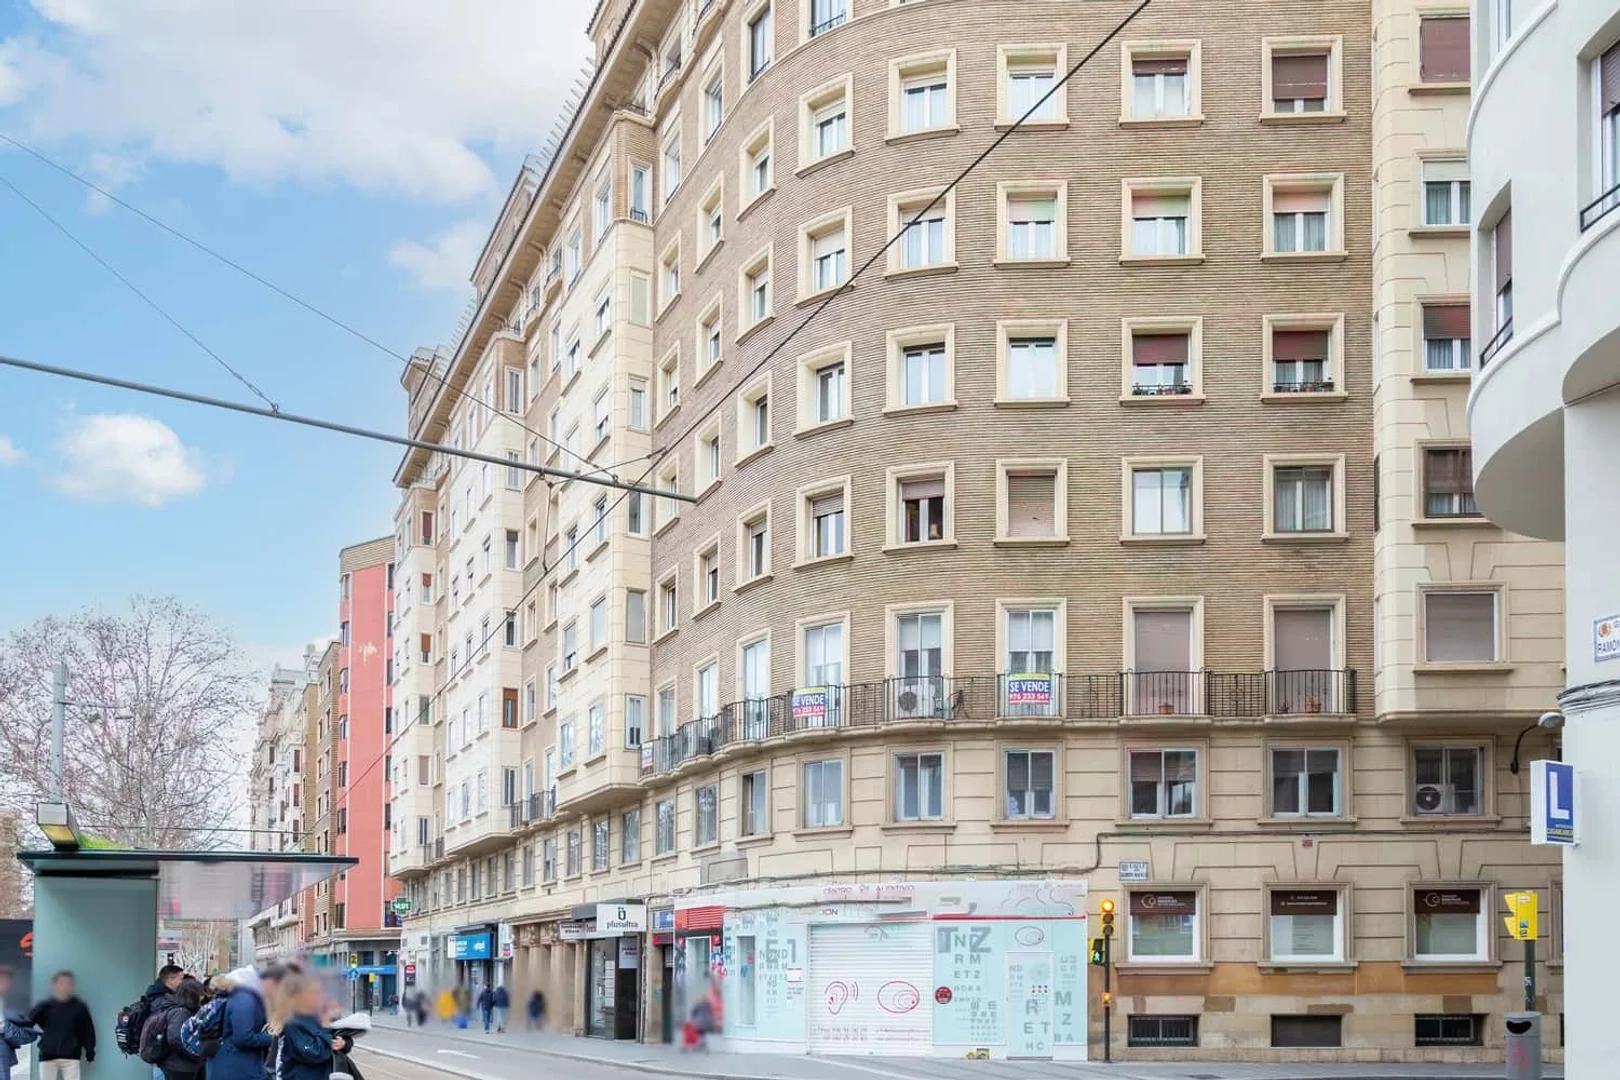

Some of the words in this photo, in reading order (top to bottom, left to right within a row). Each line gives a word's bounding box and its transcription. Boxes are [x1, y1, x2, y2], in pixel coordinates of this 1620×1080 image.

[1009, 681, 1020, 692] SE
[1021, 680, 1049, 692] VENDE
[792, 696, 800, 707] SE
[801, 694, 824, 706] VENDE
[1549, 771, 1570, 819] L
[823, 886, 852, 895] CENTRO
[606, 920, 639, 930] plusultra
